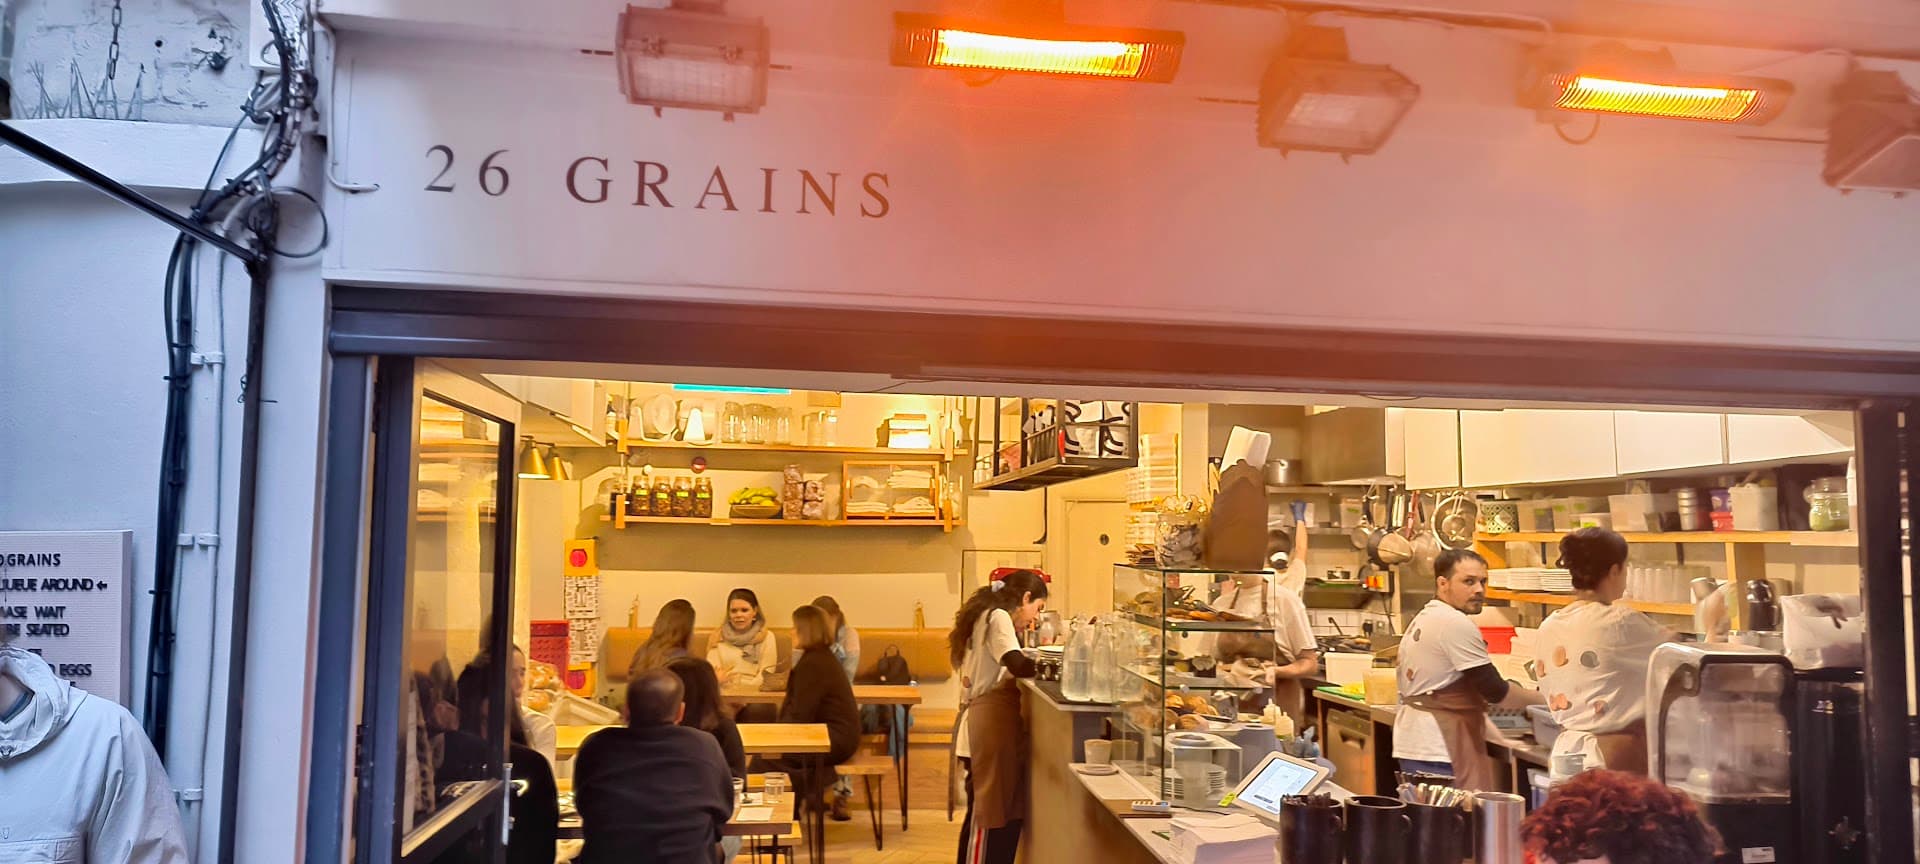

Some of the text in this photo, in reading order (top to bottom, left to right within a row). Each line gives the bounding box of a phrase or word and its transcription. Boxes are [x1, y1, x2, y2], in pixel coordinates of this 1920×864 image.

[423, 144, 891, 219] 26 GRAINS
[41, 578, 94, 591] AROUND
[34, 606, 66, 619] WAIT
[26, 623, 70, 637] SEATED
[59, 663, 92, 677] EGGS
